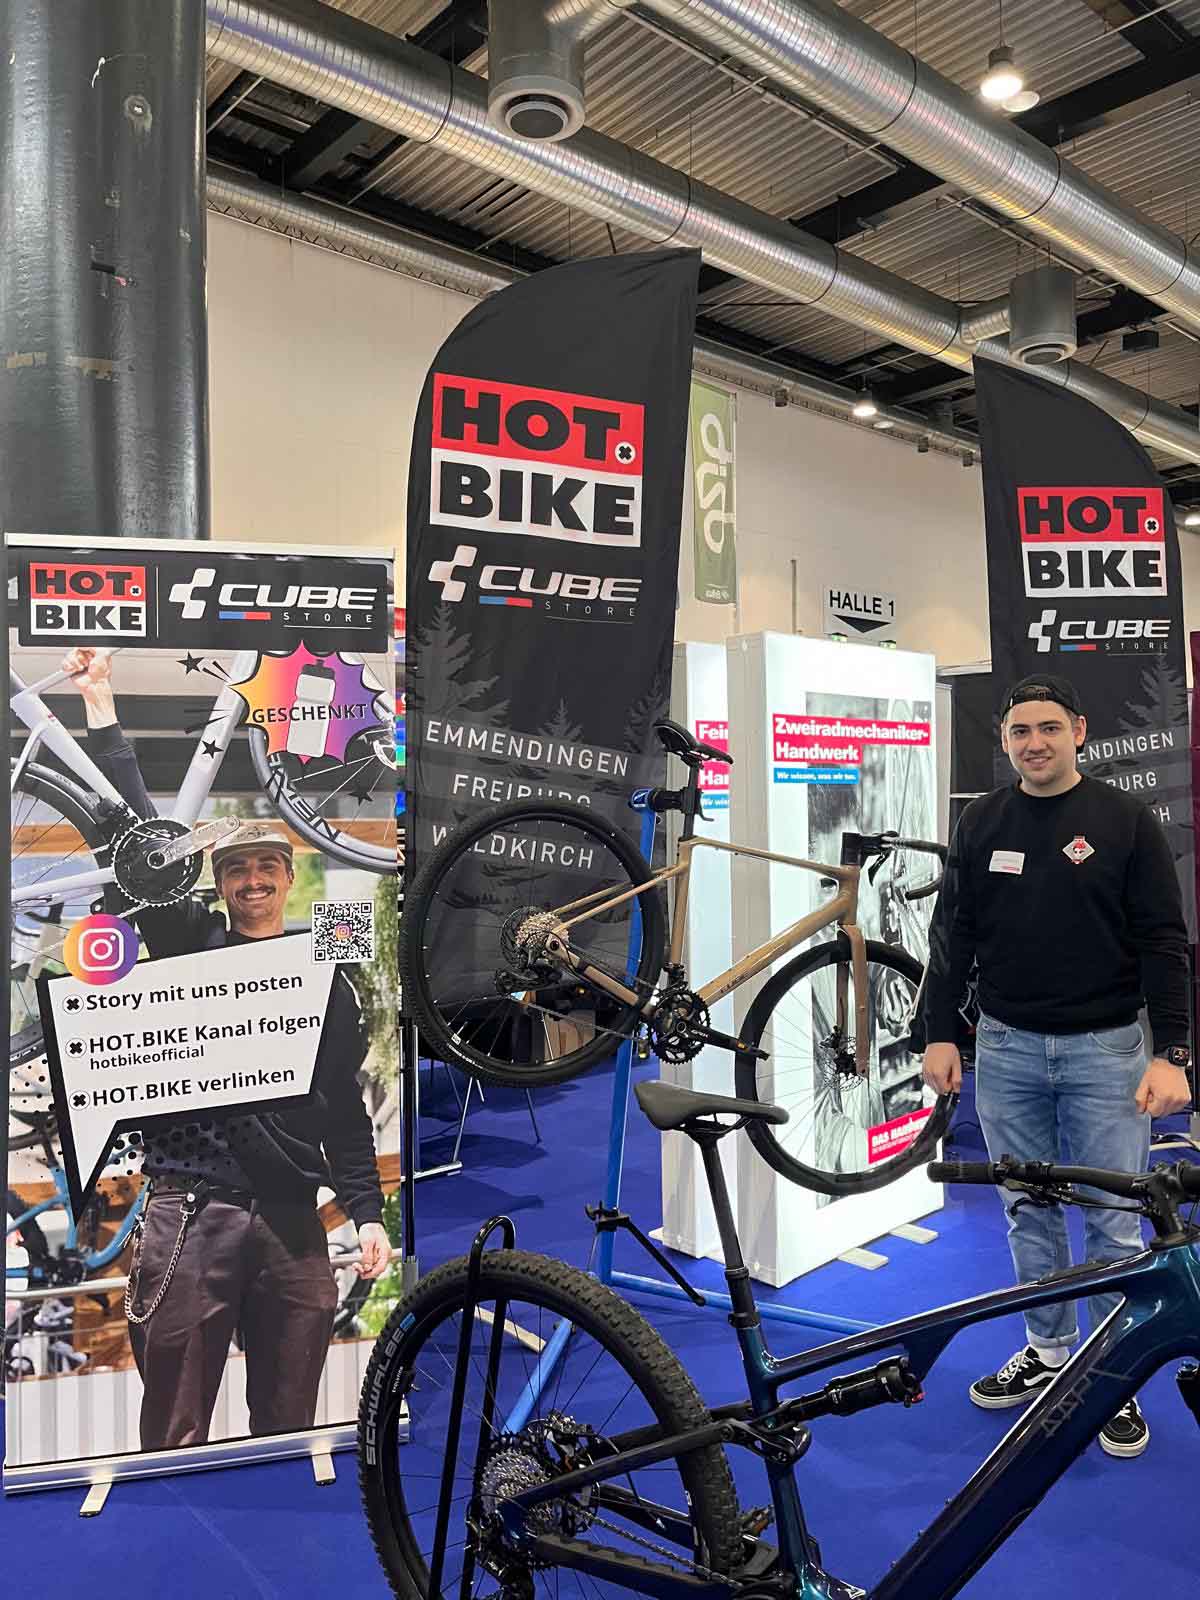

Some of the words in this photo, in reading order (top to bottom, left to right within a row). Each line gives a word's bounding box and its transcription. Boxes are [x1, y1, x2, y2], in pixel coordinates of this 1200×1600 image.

[440, 461, 635, 536] BIKE
[1027, 550, 1162, 589] BIKE
[218, 583, 377, 610] CUBE
[478, 565, 642, 602] CUBE
[545, 601, 635, 617] STORE
[829, 590, 882, 615] HALLE
[888, 600, 895, 616] 1
[35, 604, 142, 631] BIKE
[283, 612, 373, 624] STORE
[1059, 620, 1171, 640] CUBE
[1105, 642, 1168, 650] STORE
[252, 704, 368, 723] GESCHENKT
[775, 717, 929, 741] Zweiradmechaniker-
[426, 720, 629, 777] EMMENDINGEN
[776, 742, 859, 761] Handwerk
[1077, 731, 1174, 763] ENDINGEN
[432, 825, 593, 869] WLDKIRCH
[86, 992, 143, 1010] Story
[150, 985, 185, 1003] mit
[191, 983, 228, 999] uns
[234, 976, 303, 999] posten
[90, 1027, 188, 1053] HOT.BIKE
[195, 1020, 252, 1041] Kanal
[258, 1015, 321, 1035] folgen
[90, 1045, 205, 1070] hotbikeofficial
[92, 1079, 192, 1106] HOT.BIKE
[198, 1069, 295, 1092] verlinken
[366, 1327, 405, 1465] SCHWALBE
